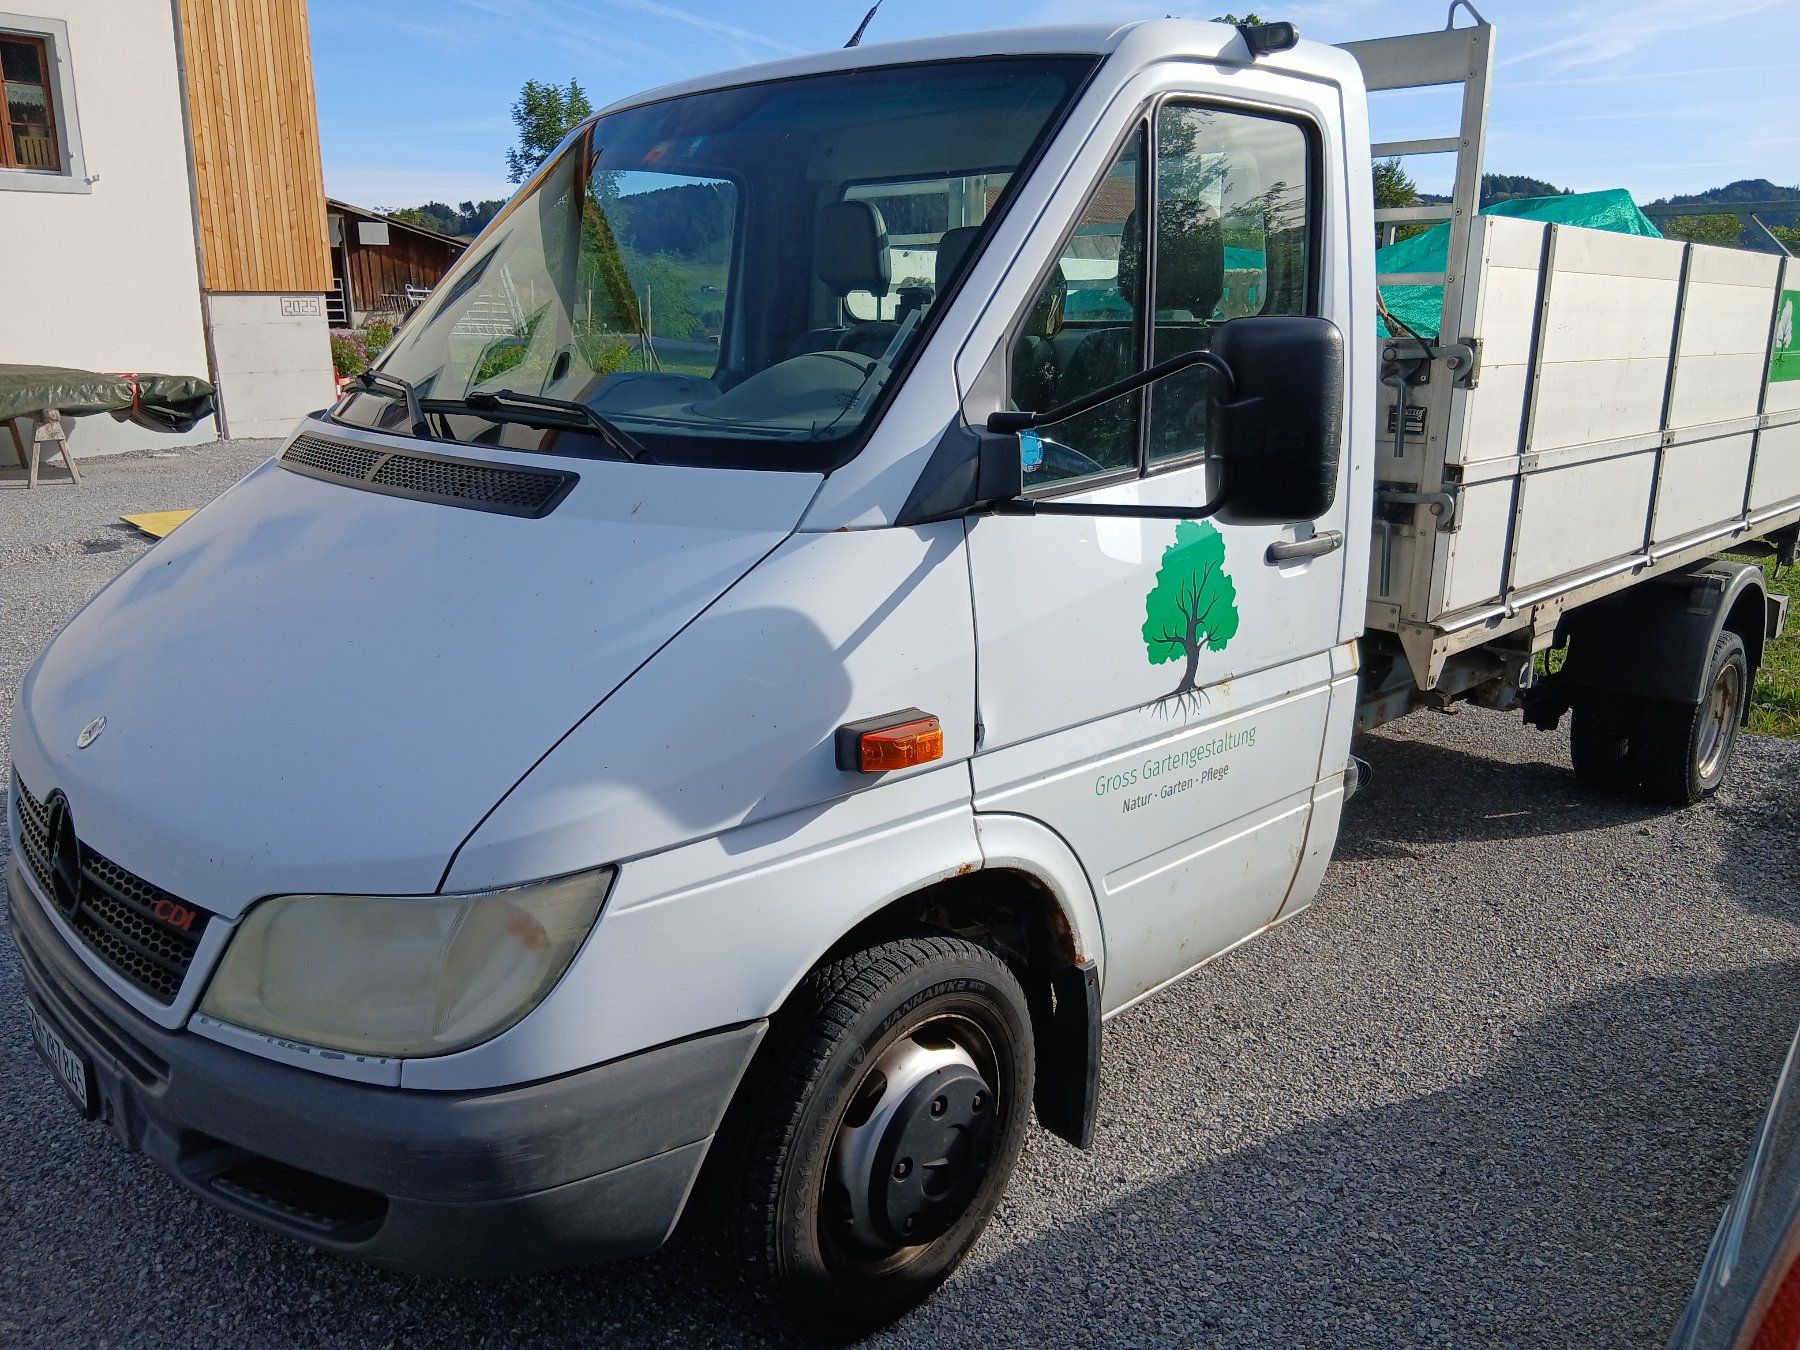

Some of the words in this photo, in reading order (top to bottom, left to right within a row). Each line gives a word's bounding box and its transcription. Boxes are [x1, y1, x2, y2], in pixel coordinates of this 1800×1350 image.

[283, 300, 318, 313] 2025
[1095, 769, 1138, 797] Gross
[1142, 726, 1257, 781] Gartengestaltung
[1122, 791, 1153, 813] Natur
[1160, 778, 1193, 799] Garten
[1201, 763, 1229, 785] Pflege
[155, 900, 196, 930] CDI
